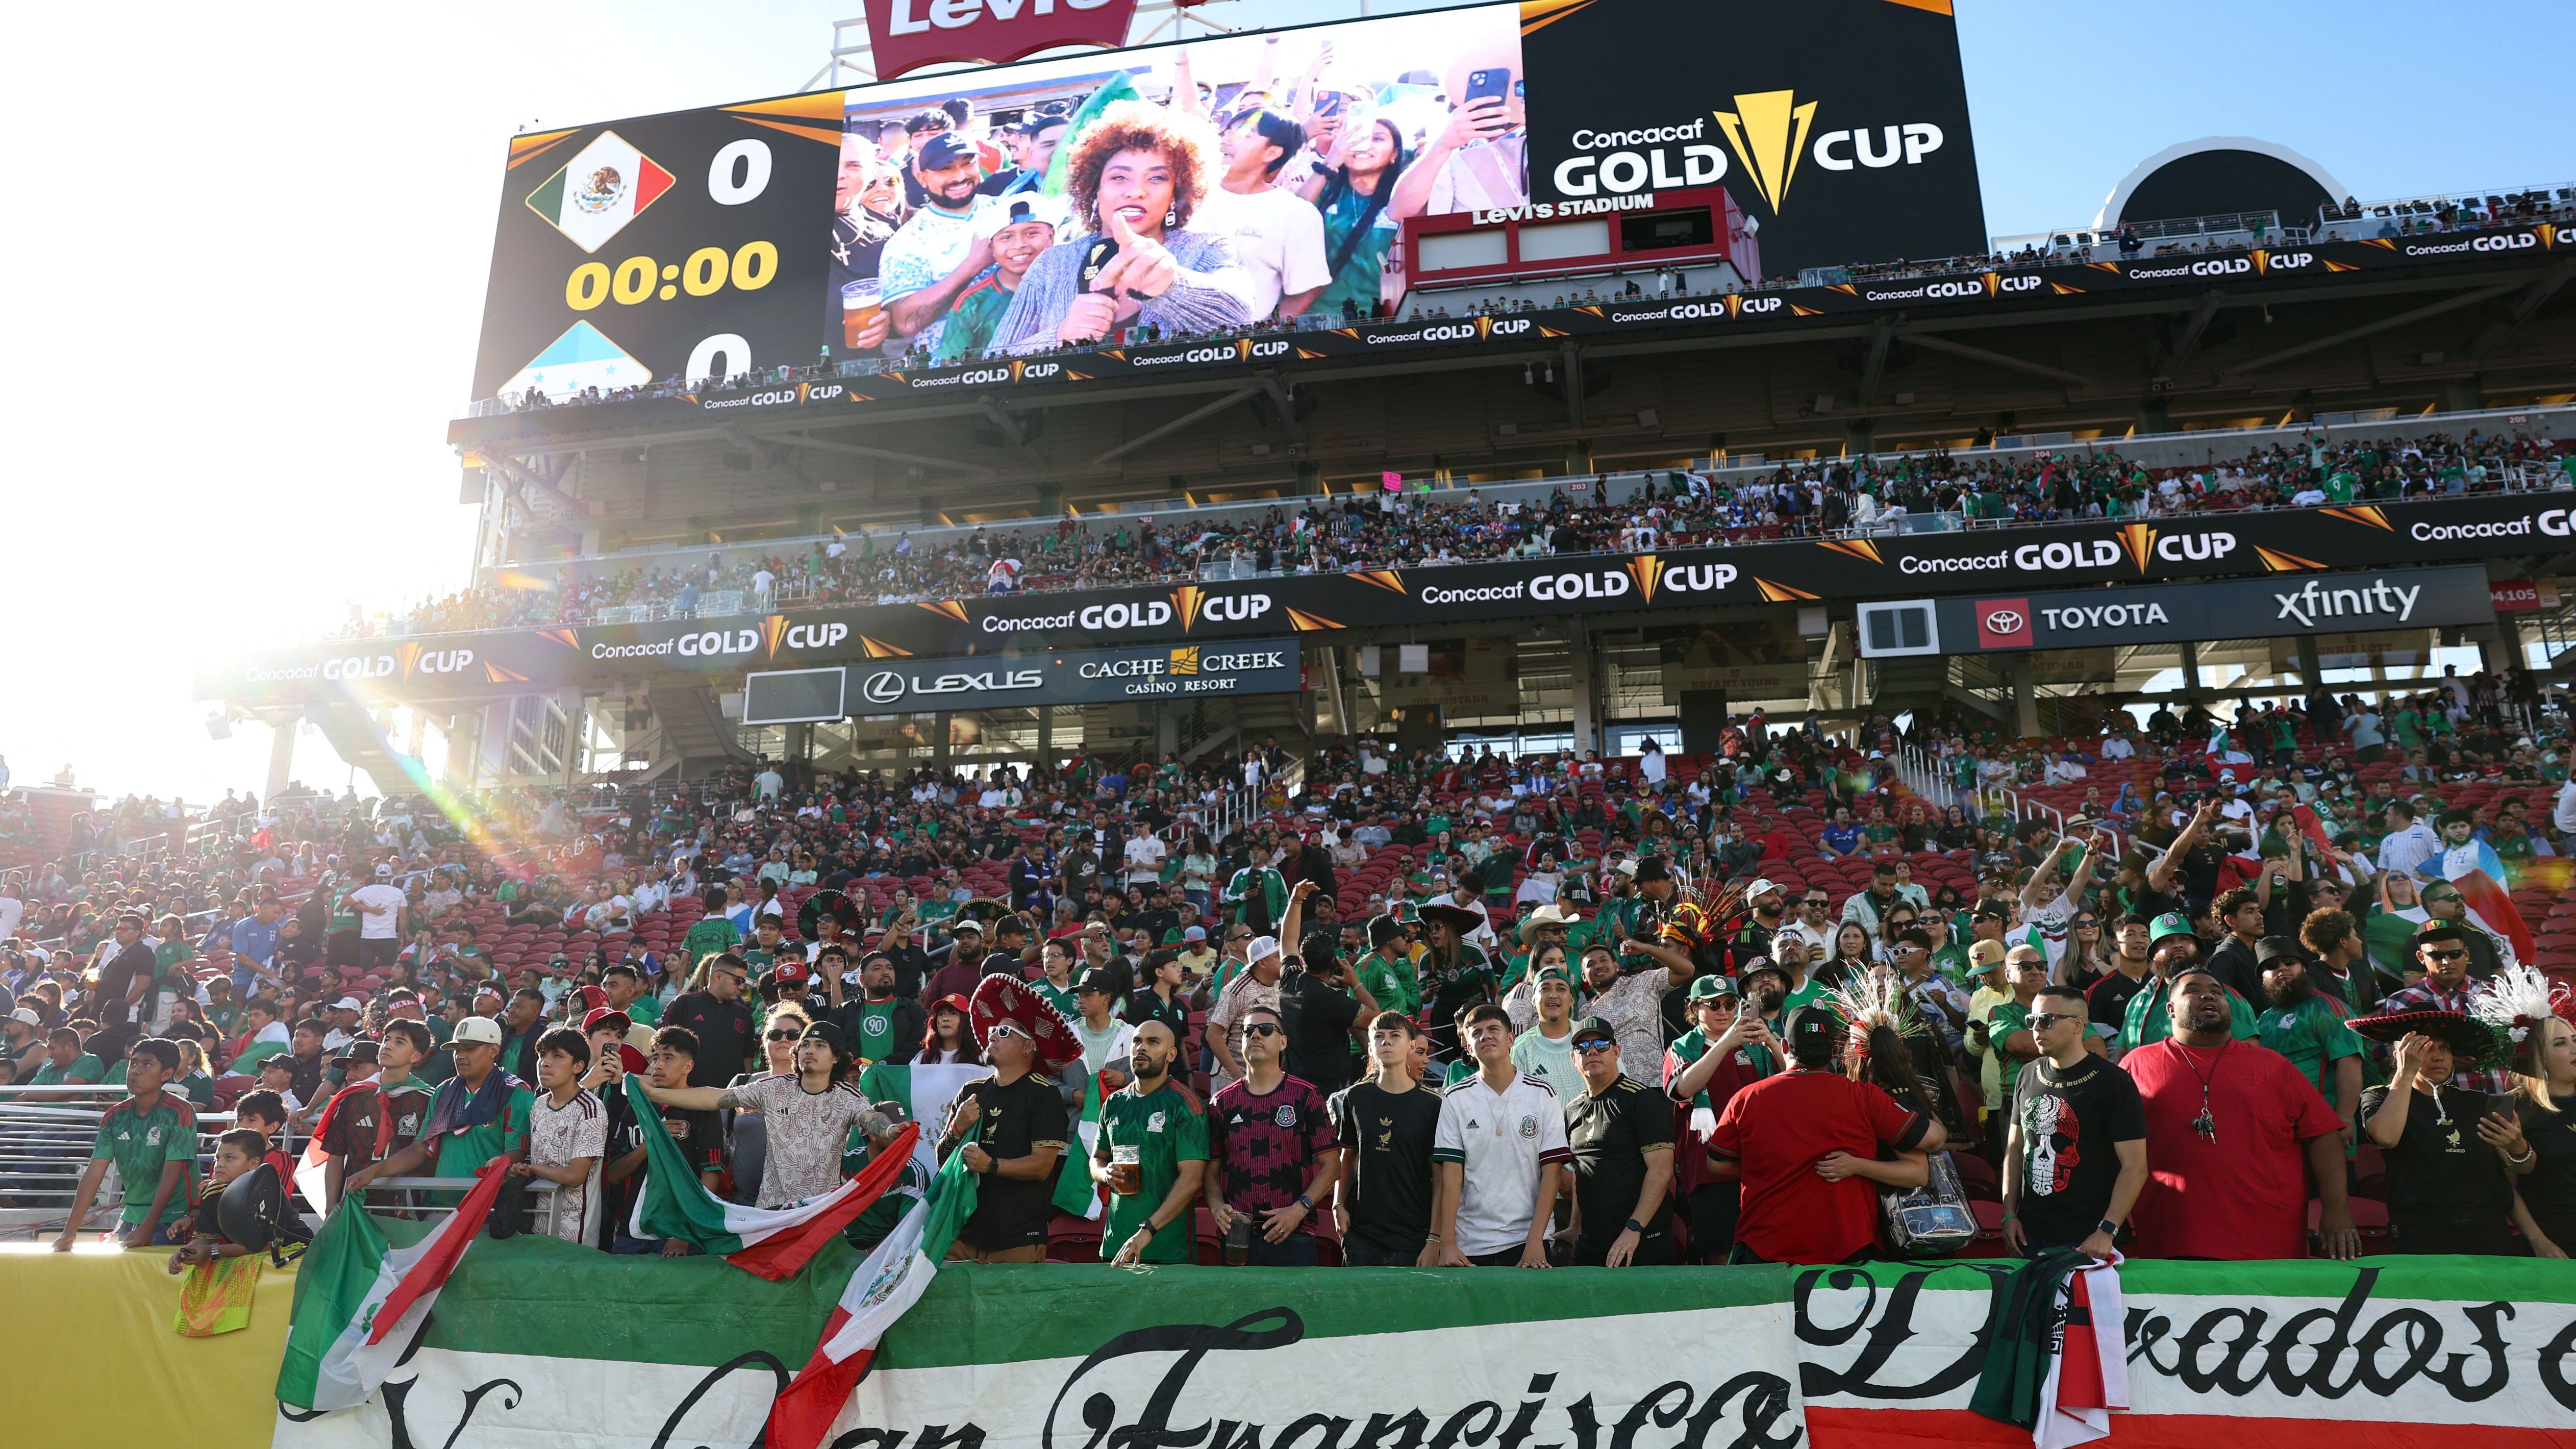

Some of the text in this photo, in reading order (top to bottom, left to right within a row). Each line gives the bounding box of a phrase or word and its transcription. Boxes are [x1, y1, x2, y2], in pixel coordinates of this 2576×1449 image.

[889, 0, 1112, 37] Lev
[1572, 118, 1704, 149] Concacaf
[1554, 123, 1943, 195] GOLD CUP
[709, 139, 771, 205] 0
[1558, 193, 1654, 216] STADIUM
[2406, 234, 2536, 255] Concacaf GOLD
[565, 240, 779, 311] 00:00
[2130, 253, 2313, 279] Concacaf GOLD CUP
[1867, 276, 2041, 301] Concacaf GOLD CUP
[1612, 298, 1781, 322] Concacaf GOLD CUP
[1367, 319, 1530, 344] Concacaf GOLD CUP
[685, 333, 752, 391] 0
[1134, 341, 1288, 366] Concacaf GOLD CUP
[912, 363, 1059, 387] Concacaf GOLD CUP
[705, 385, 842, 409] Concacaf GOLD CUP
[2333, 480, 2341, 491] 9
[2412, 516, 2531, 541] Concacaf
[1900, 533, 2236, 573] Concacaf GOLD CUP
[1422, 564, 1737, 604] Concacaf GOLD CUP
[2507, 589, 2537, 601] 105
[983, 594, 1271, 632] Concacaf GOLD CUP
[2275, 579, 2420, 626] xfinity
[2042, 603, 2168, 629] TOYOTA
[592, 623, 847, 659] Concacaf GOLD CUP
[2317, 645, 2357, 655] ONNIE
[245, 650, 473, 683] Concacaf GOLD CUP
[1080, 652, 1284, 678] CACHE CREEK
[1730, 669, 1739, 677] 97
[2031, 661, 2084, 671] ATHMAN
[912, 670, 1042, 693] LEXUS
[1126, 679, 1236, 694] CASINO RESORT
[1691, 677, 1781, 689] BRYANT YOUNG
[1434, 694, 1489, 705] MONTANA
[878, 726, 918, 736] PATRICK
[1572, 890, 1581, 899] LOS
[869, 1019, 883, 1033] 90
[2066, 1069, 2099, 1087] MUNDIAL
[628, 1125, 645, 1150] 10
